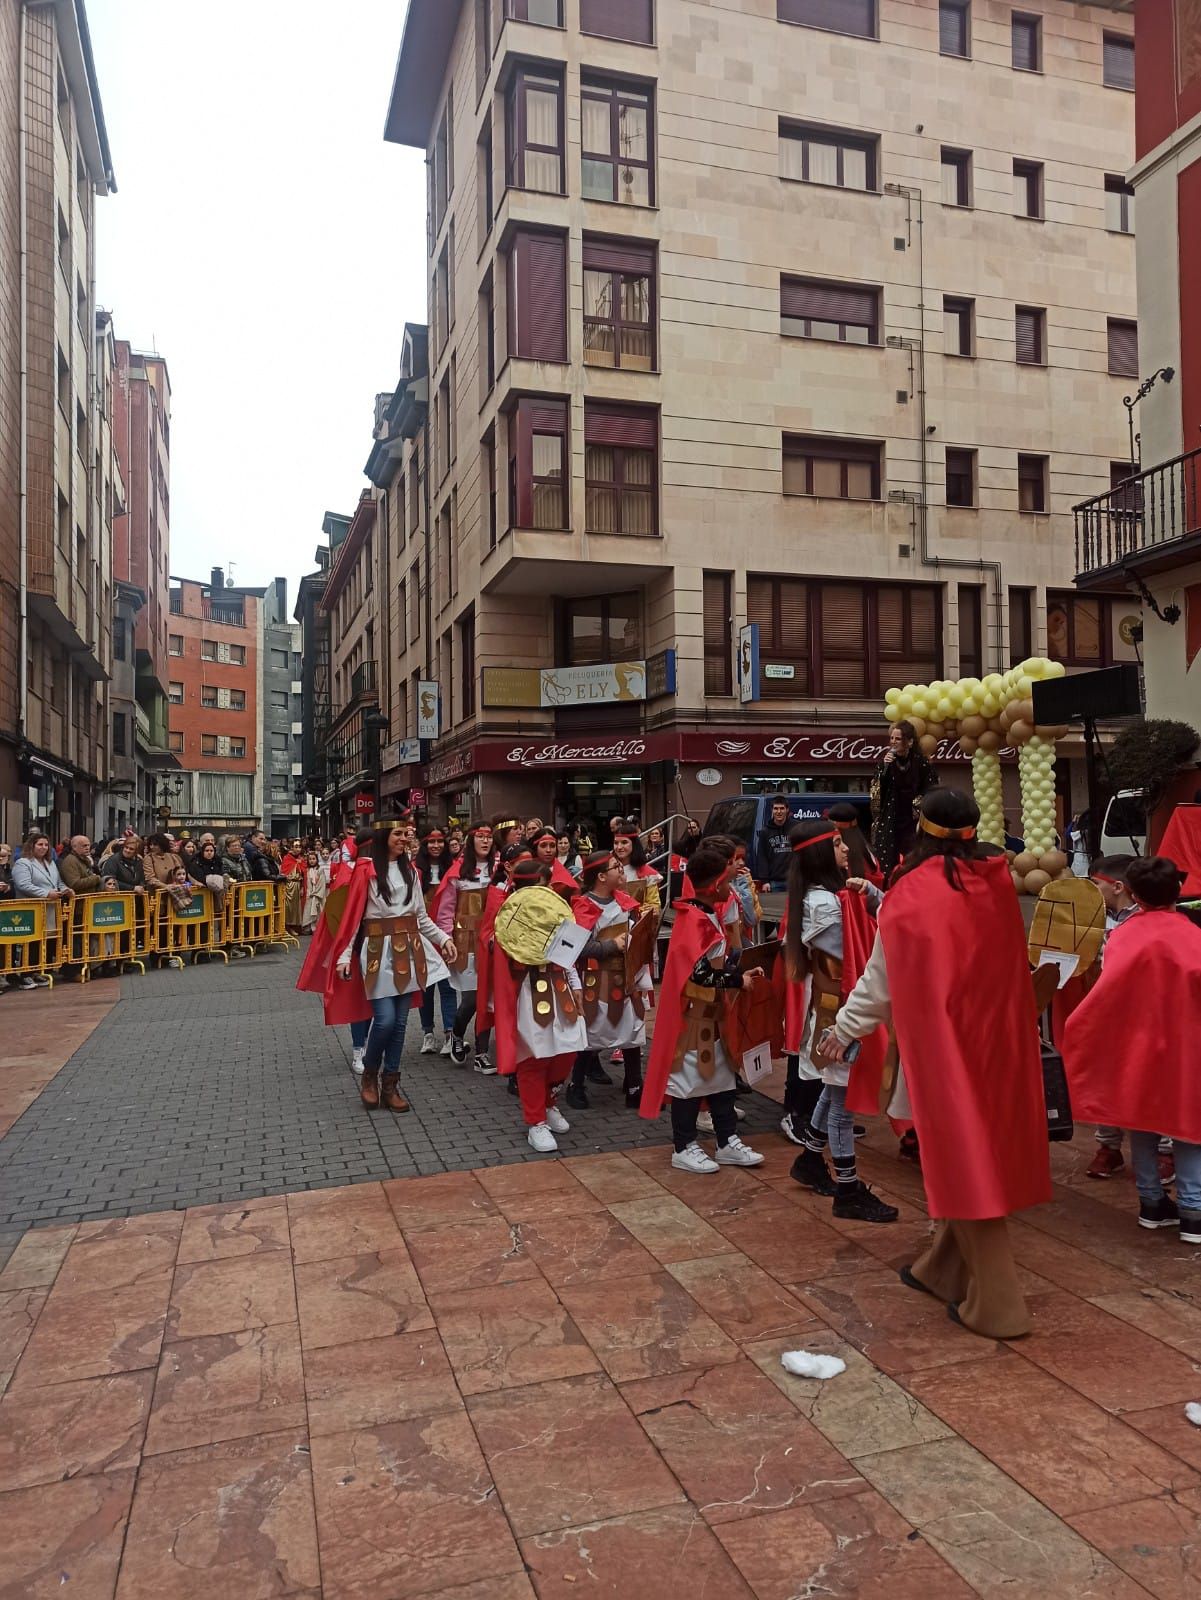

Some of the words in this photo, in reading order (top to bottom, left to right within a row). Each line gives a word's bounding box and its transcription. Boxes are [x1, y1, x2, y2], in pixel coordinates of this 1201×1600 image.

[575, 682, 609, 699] ELY
[420, 725, 437, 733] ELY
[506, 746, 535, 761] El
[534, 739, 646, 760] Mercadillo
[763, 737, 810, 758] El
[793, 808, 821, 820] Astur
[561, 939, 574, 949] 1
